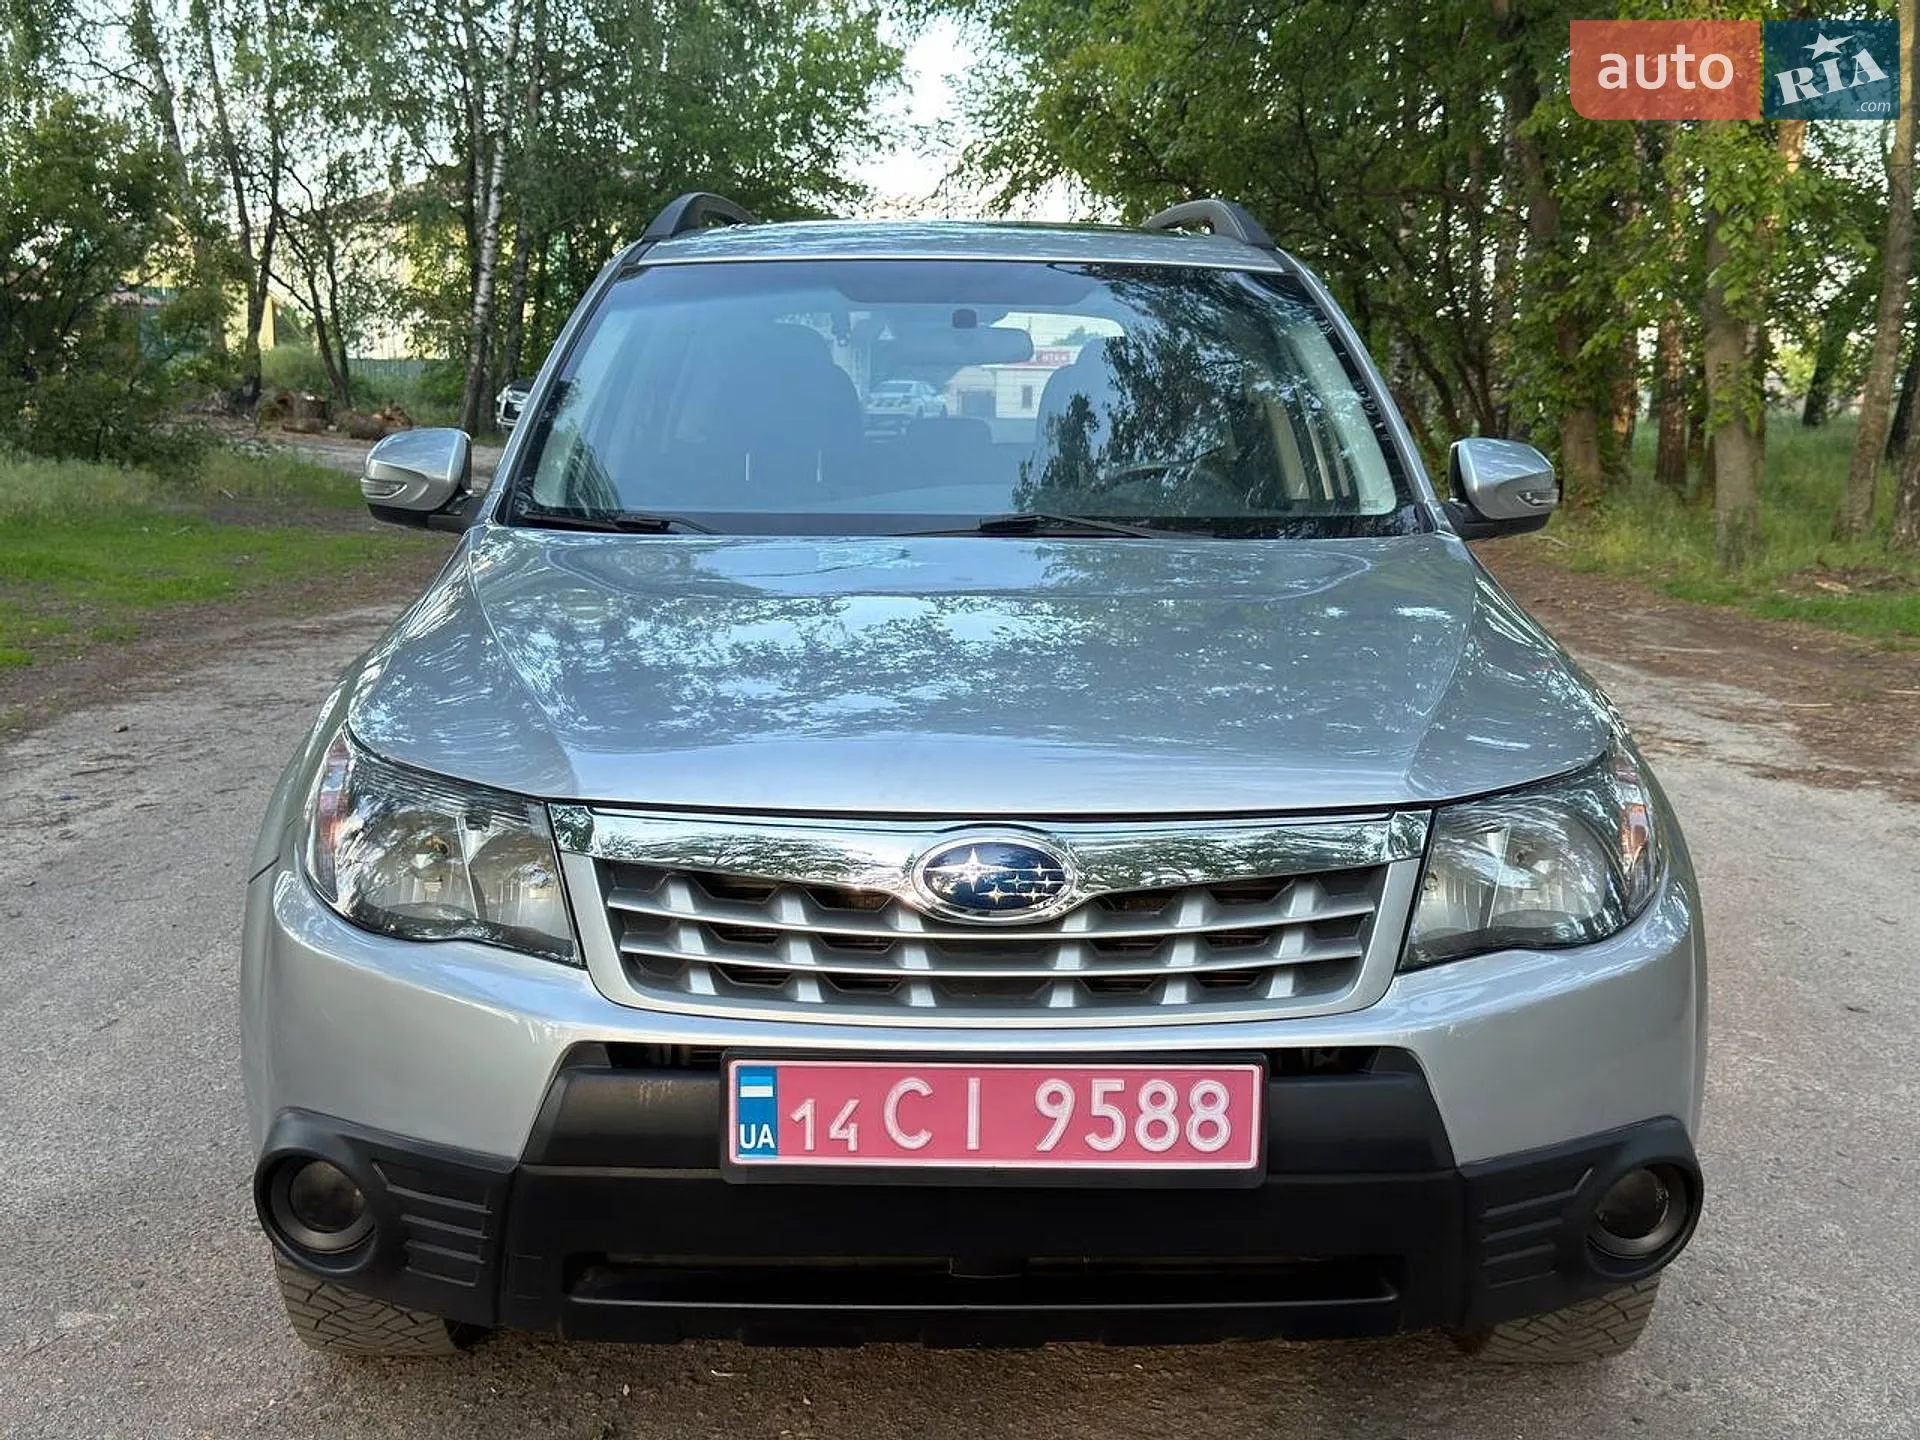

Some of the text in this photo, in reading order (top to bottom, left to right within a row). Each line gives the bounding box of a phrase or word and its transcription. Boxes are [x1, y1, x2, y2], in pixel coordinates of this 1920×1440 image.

[739, 1124, 776, 1149] UA
[790, 1098, 858, 1152] 14
[1034, 1079, 1231, 1153] 9588
